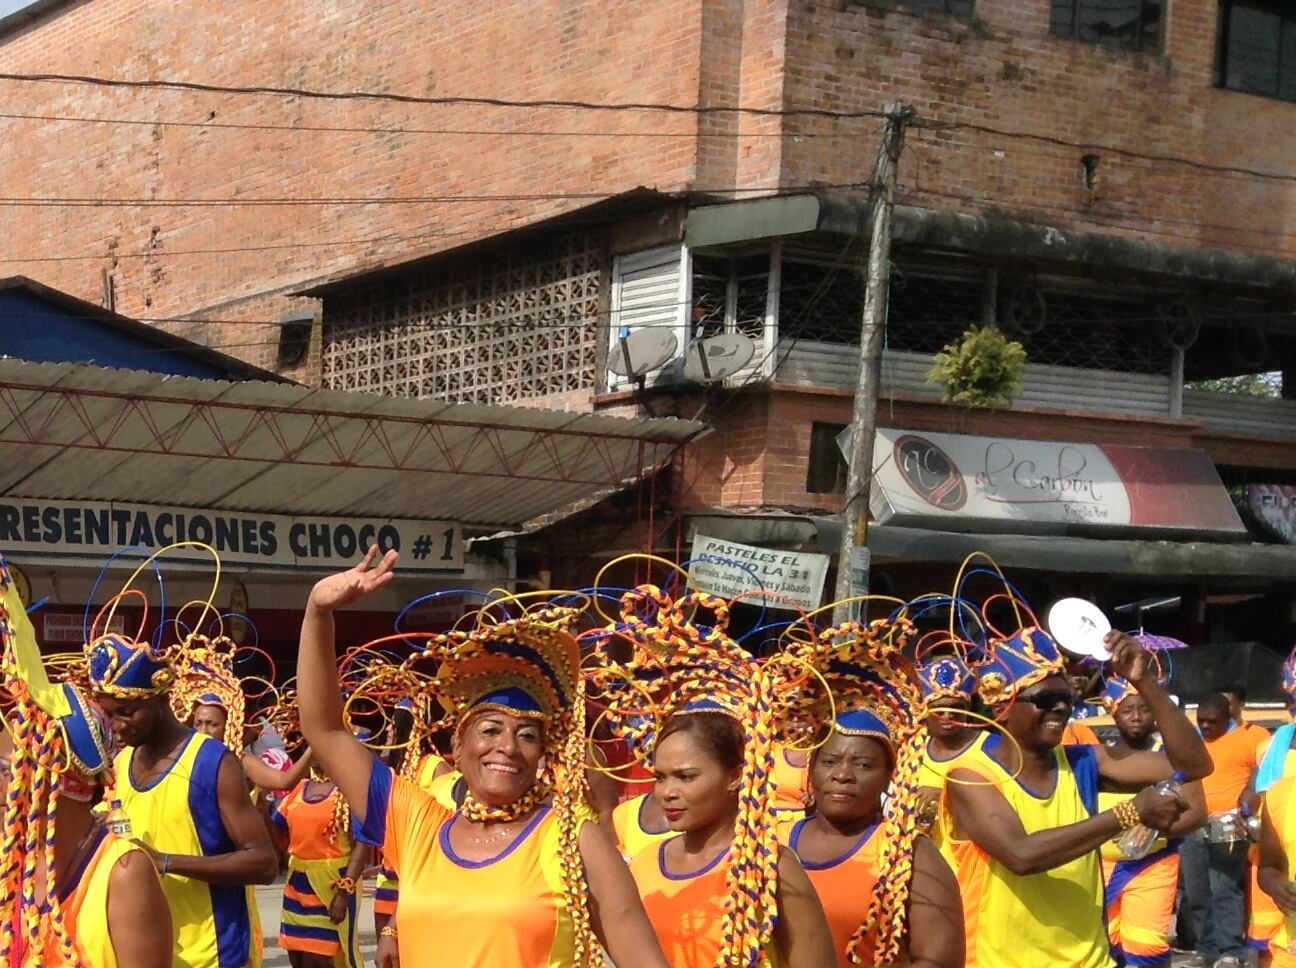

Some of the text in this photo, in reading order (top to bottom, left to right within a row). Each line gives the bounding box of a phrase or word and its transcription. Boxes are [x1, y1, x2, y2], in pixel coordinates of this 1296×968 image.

[289, 522, 401, 559] CHOCO
[705, 542, 800, 567] PASTELES EL
[762, 567, 784, 577] LA
